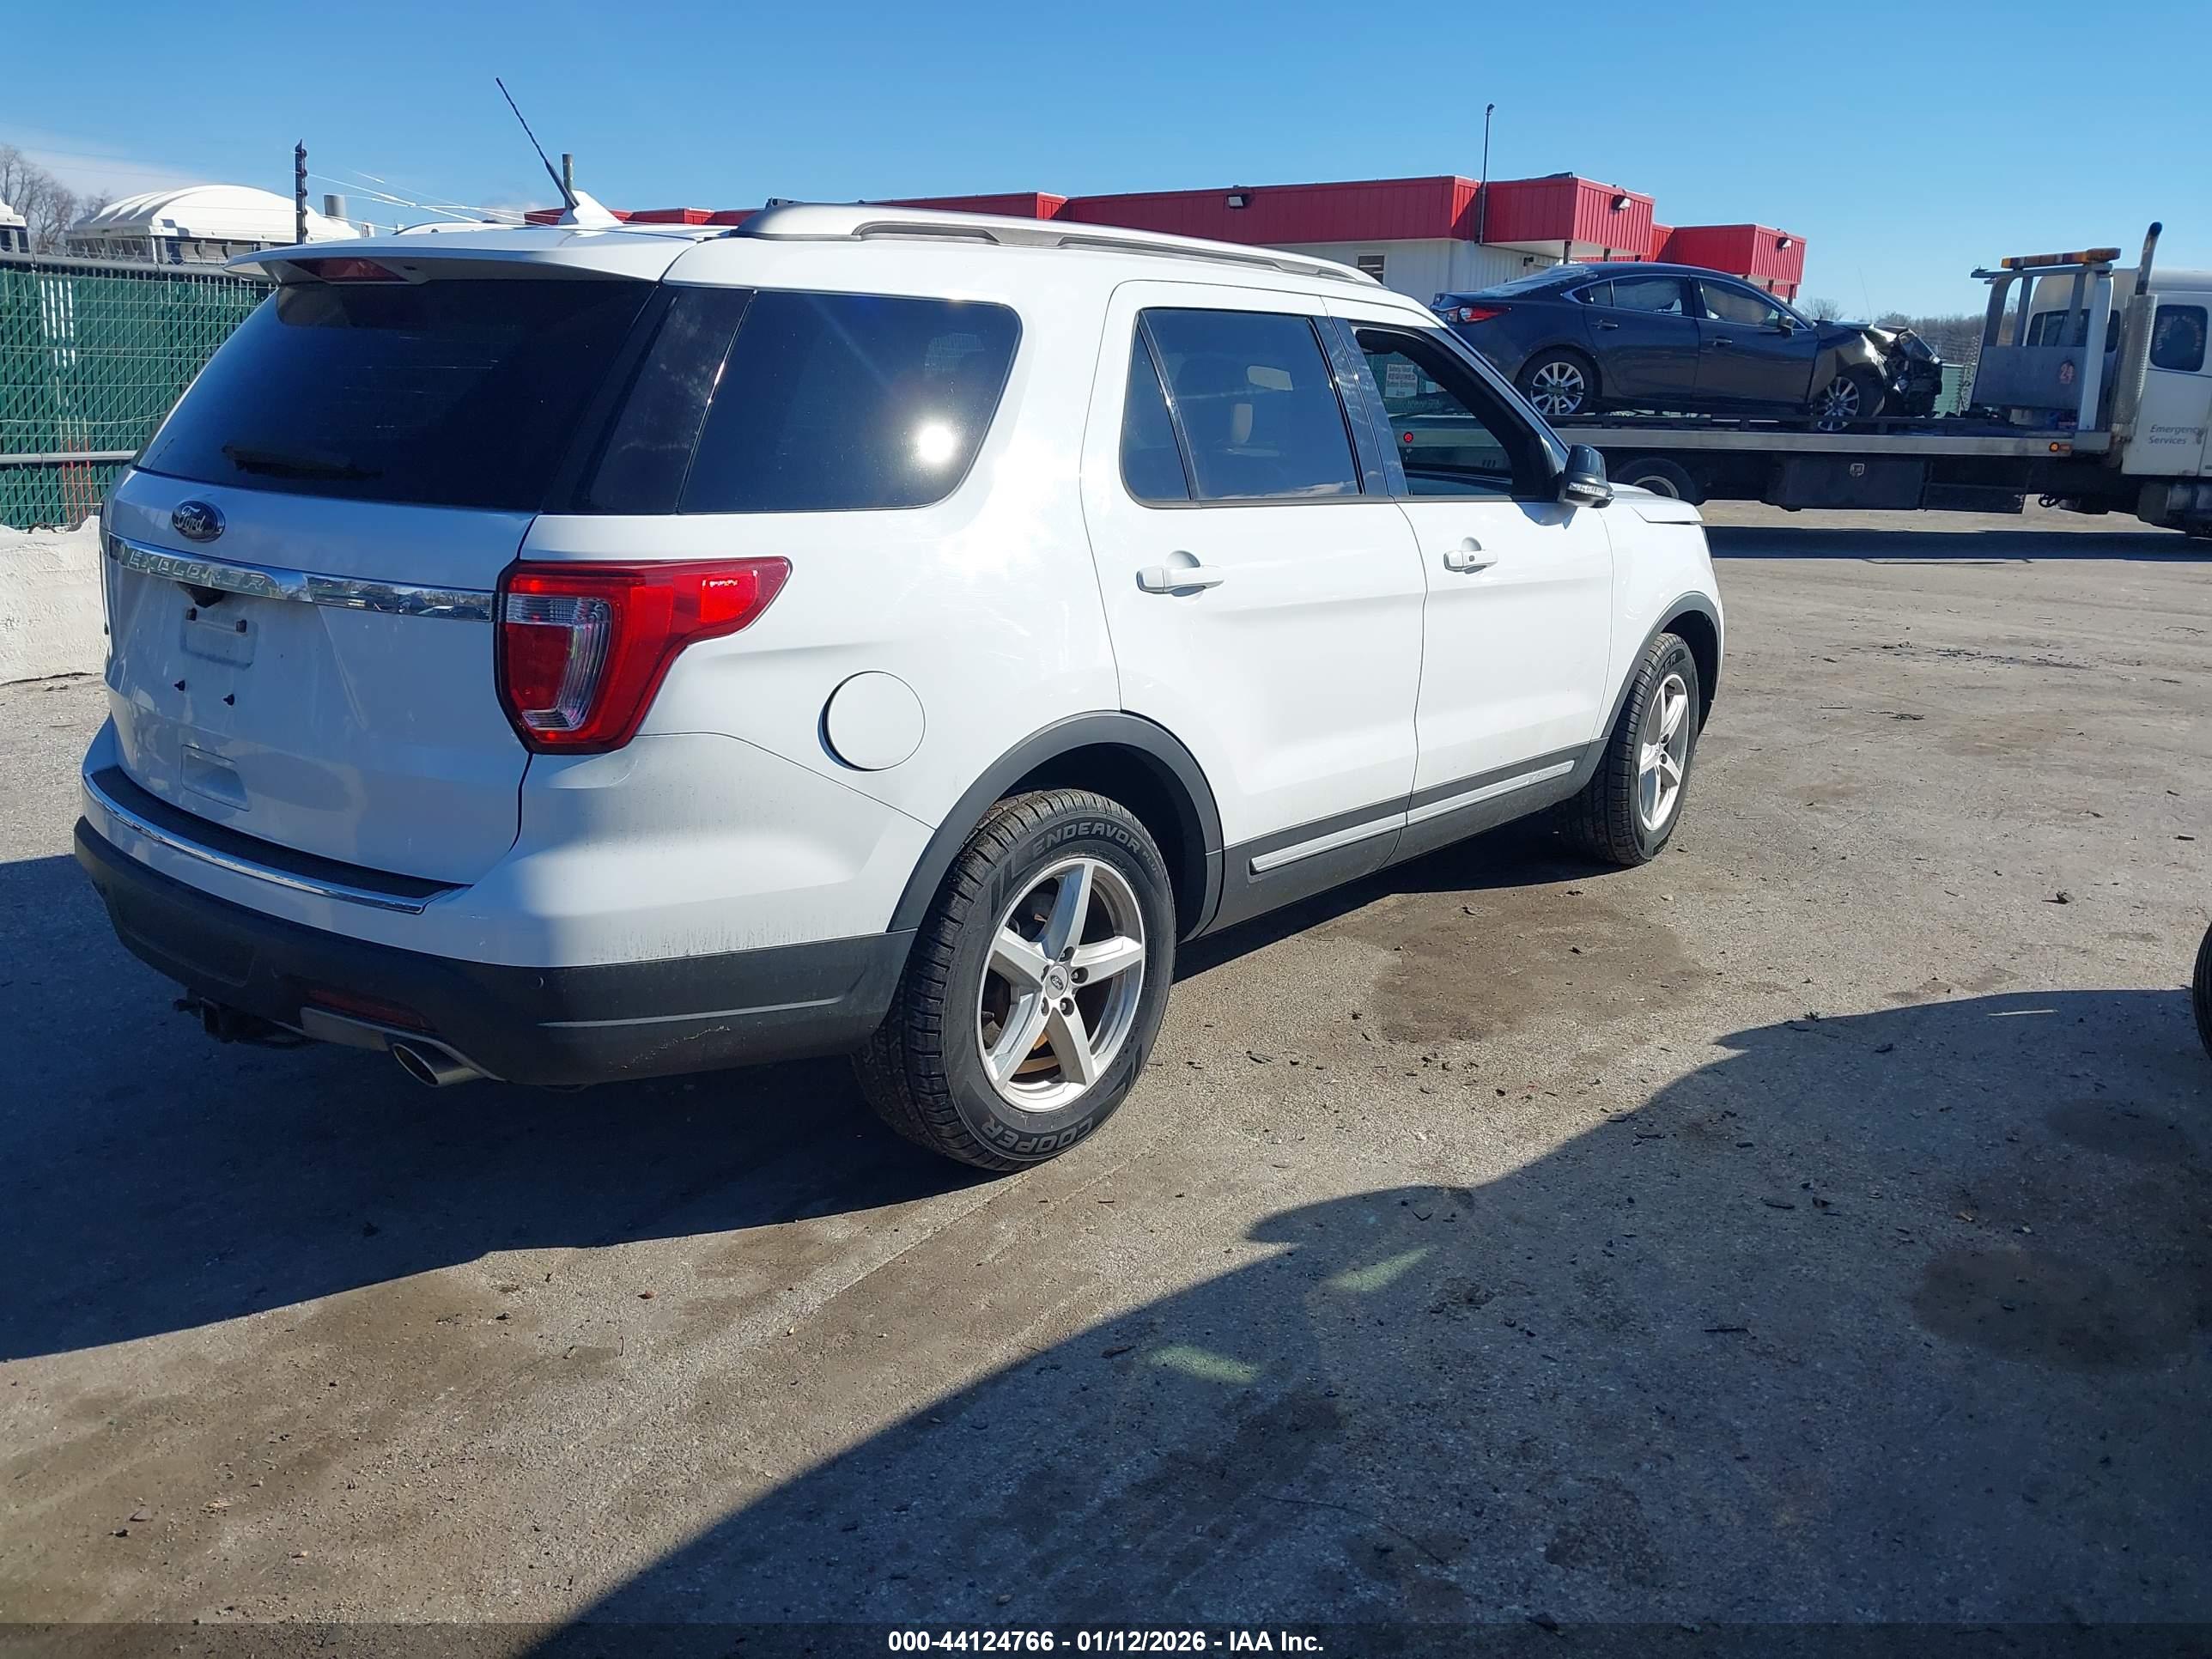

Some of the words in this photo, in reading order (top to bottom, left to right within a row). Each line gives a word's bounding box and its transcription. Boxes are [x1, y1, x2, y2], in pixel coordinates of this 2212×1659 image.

[2148, 435, 2186, 445] Services
[174, 505, 206, 532] Ford
[130, 550, 266, 591] EXPLORER
[1033, 822, 1141, 855] ENDEAVOR
[981, 1115, 1093, 1153] COOPER
